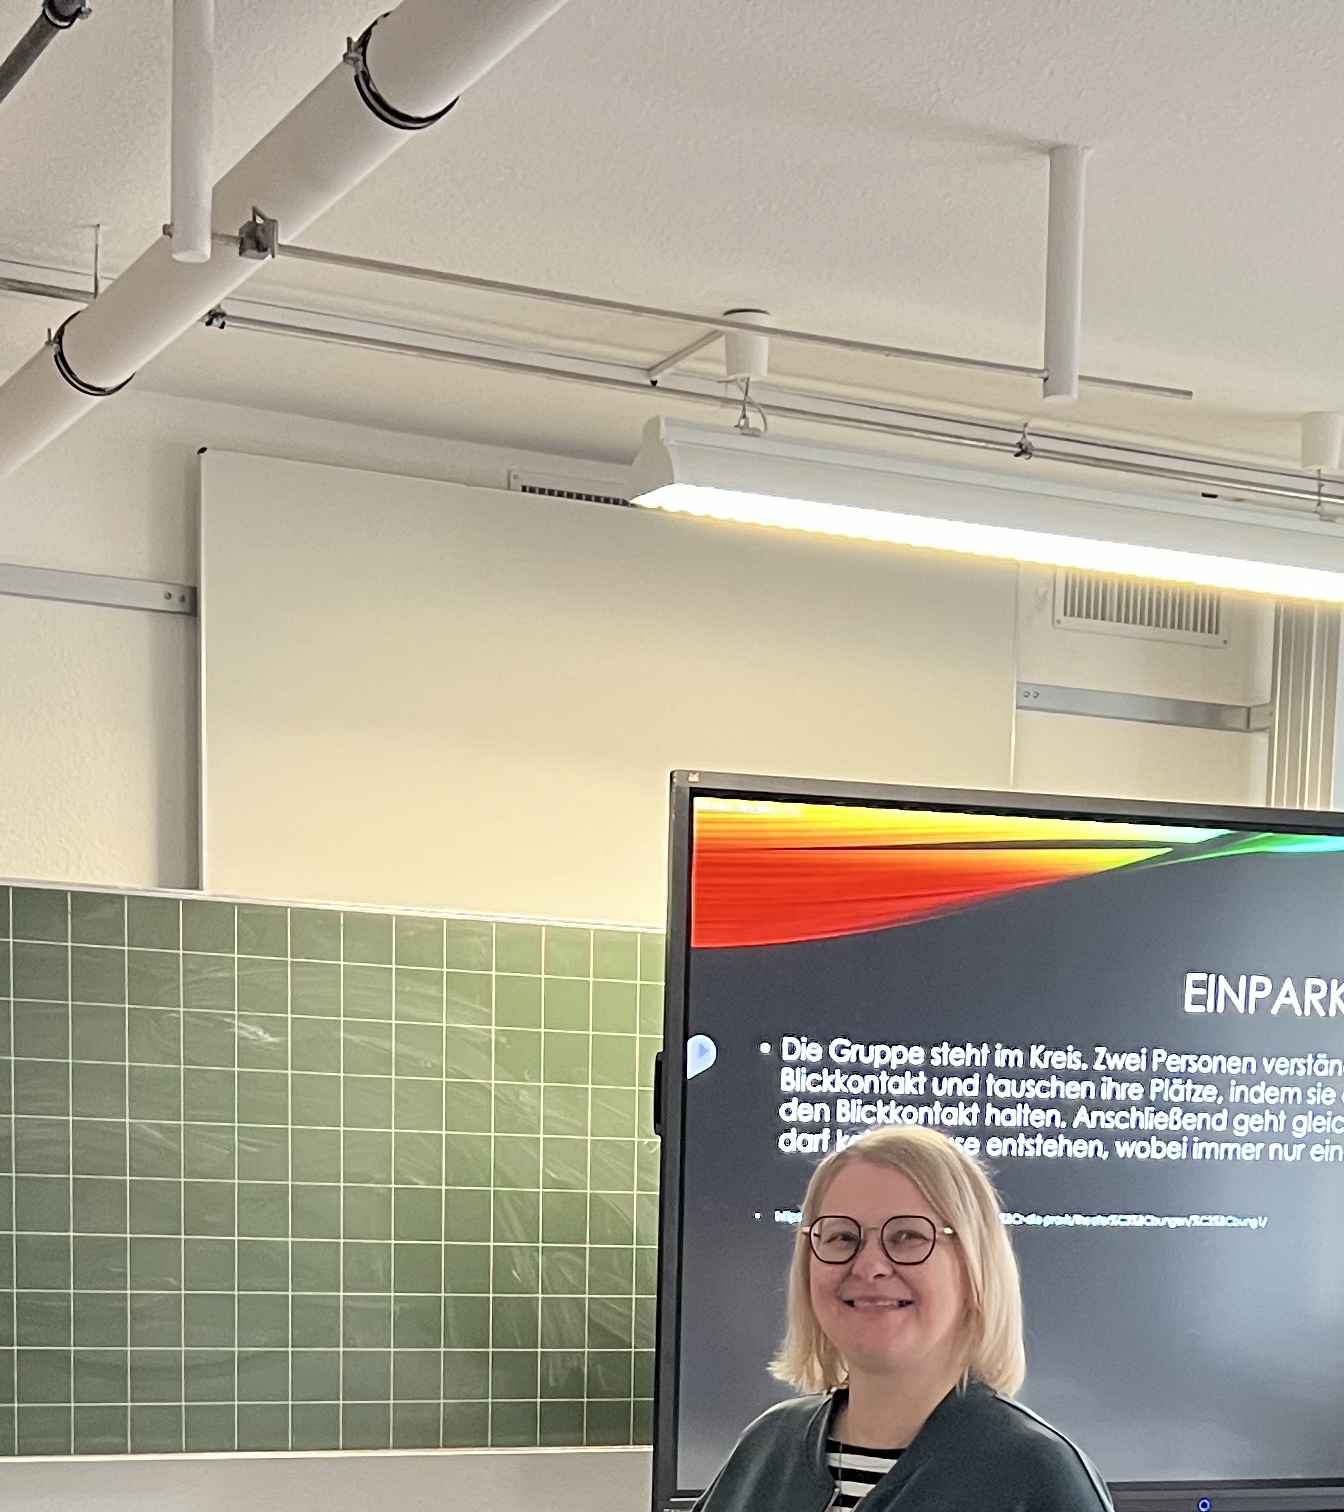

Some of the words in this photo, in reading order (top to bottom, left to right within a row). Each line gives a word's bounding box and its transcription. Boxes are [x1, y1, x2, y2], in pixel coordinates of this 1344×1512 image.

[781, 1036, 823, 1063] Die
[829, 1038, 925, 1069] Gruppe
[930, 1041, 989, 1067] steht
[994, 1043, 1024, 1068] im
[1030, 1045, 1088, 1070] Kreis.
[1093, 1046, 1147, 1072] Zwei
[1152, 1048, 1256, 1074] Personen
[780, 1067, 927, 1095] Blickkontakt
[932, 1073, 980, 1097] und
[986, 1073, 1095, 1100] tauschen
[1100, 1077, 1144, 1101] ihre
[1150, 1078, 1224, 1105] Plätze,
[1229, 1080, 1302, 1105] indem
[1306, 1082, 1336, 1106] sie
[778, 1097, 831, 1123] den
[836, 1099, 980, 1126] Blickkontakt
[984, 1102, 1067, 1129] halten.
[1072, 1105, 1229, 1132] Anschließend
[1233, 1110, 1287, 1137] geht
[777, 1128, 830, 1153] darf
[986, 1133, 1109, 1160] entstehen,
[1115, 1136, 1189, 1160] wobei
[1192, 1137, 1265, 1161] immer
[1269, 1141, 1306, 1162] nur
[1309, 1139, 1344, 1163] ein
